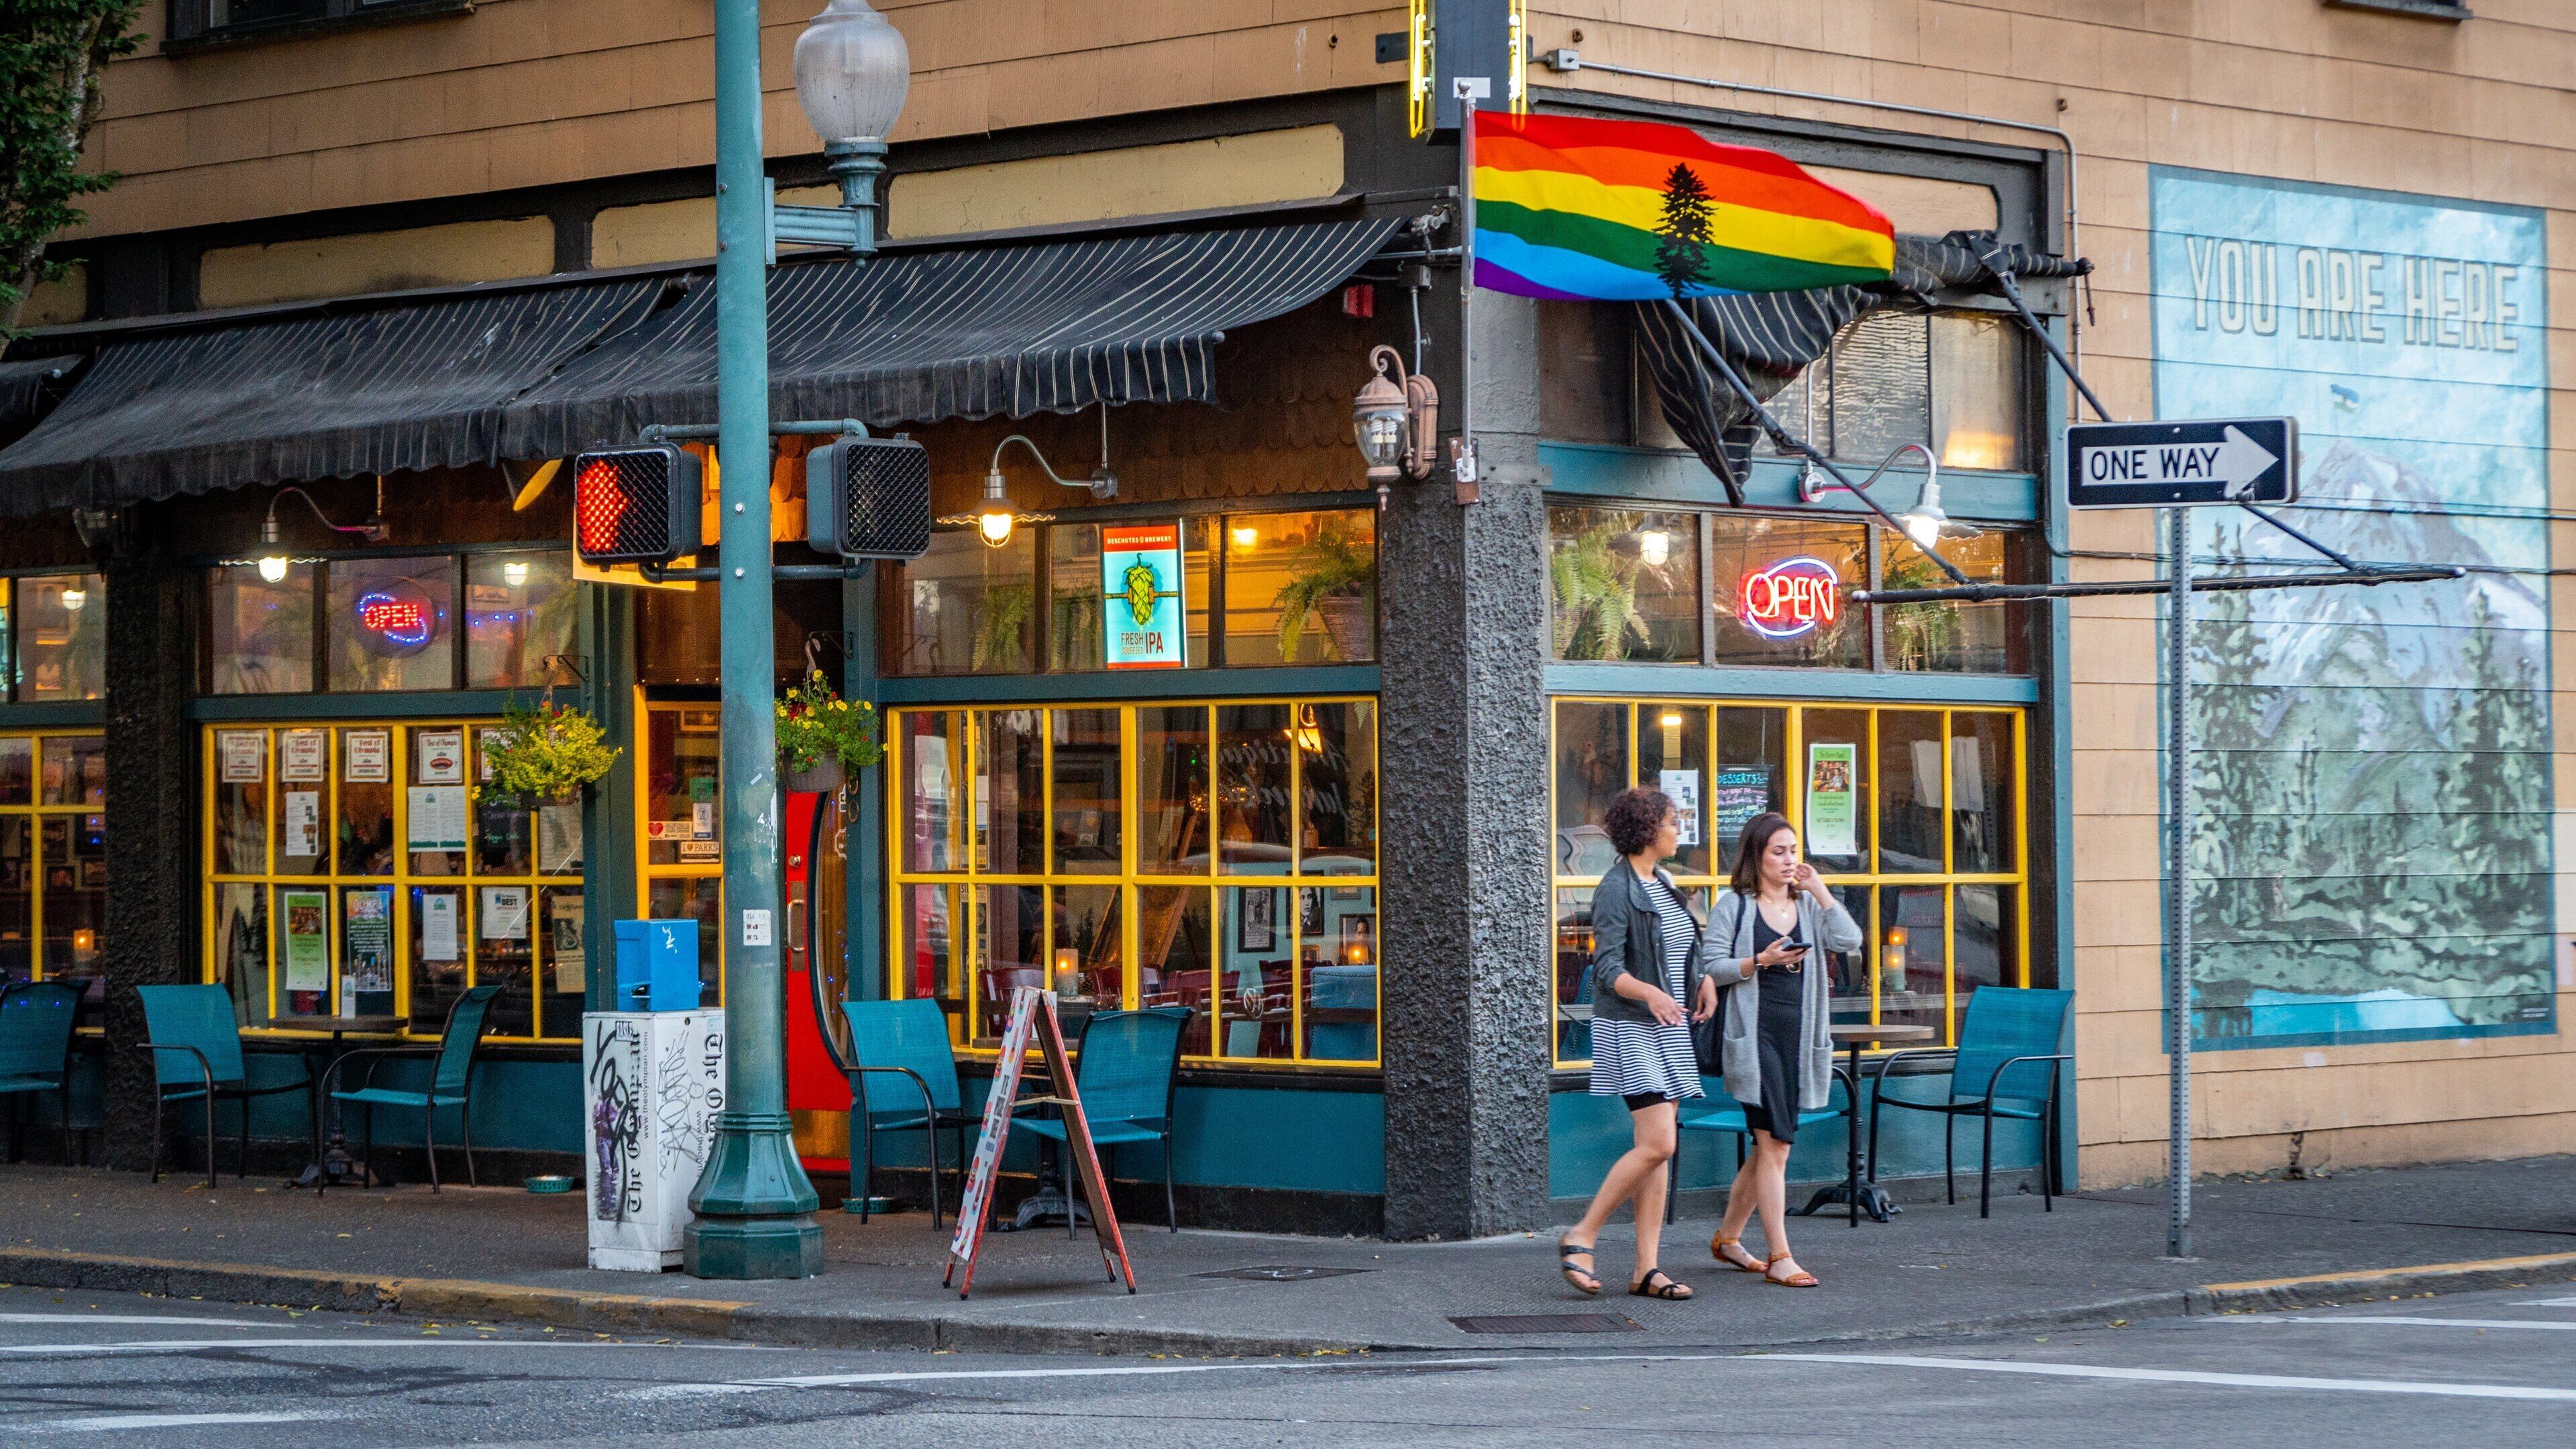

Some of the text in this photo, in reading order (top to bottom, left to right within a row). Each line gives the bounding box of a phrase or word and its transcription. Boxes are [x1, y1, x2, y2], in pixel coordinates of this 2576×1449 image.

[2186, 235, 2519, 353] YOU ARE HERE
[2091, 447, 2220, 480] ONE WAY
[1746, 573, 1835, 621] OPEN
[364, 604, 419, 628] OPEN
[1121, 633, 1144, 645] FRESH
[1121, 646, 1144, 655] SQUEEZED
[1145, 631, 1164, 654] IPA
[1717, 773, 1757, 784] DESSERTS
[682, 843, 718, 852] I PARKS
[702, 1033, 723, 1079] The
[627, 1168, 643, 1213] The
